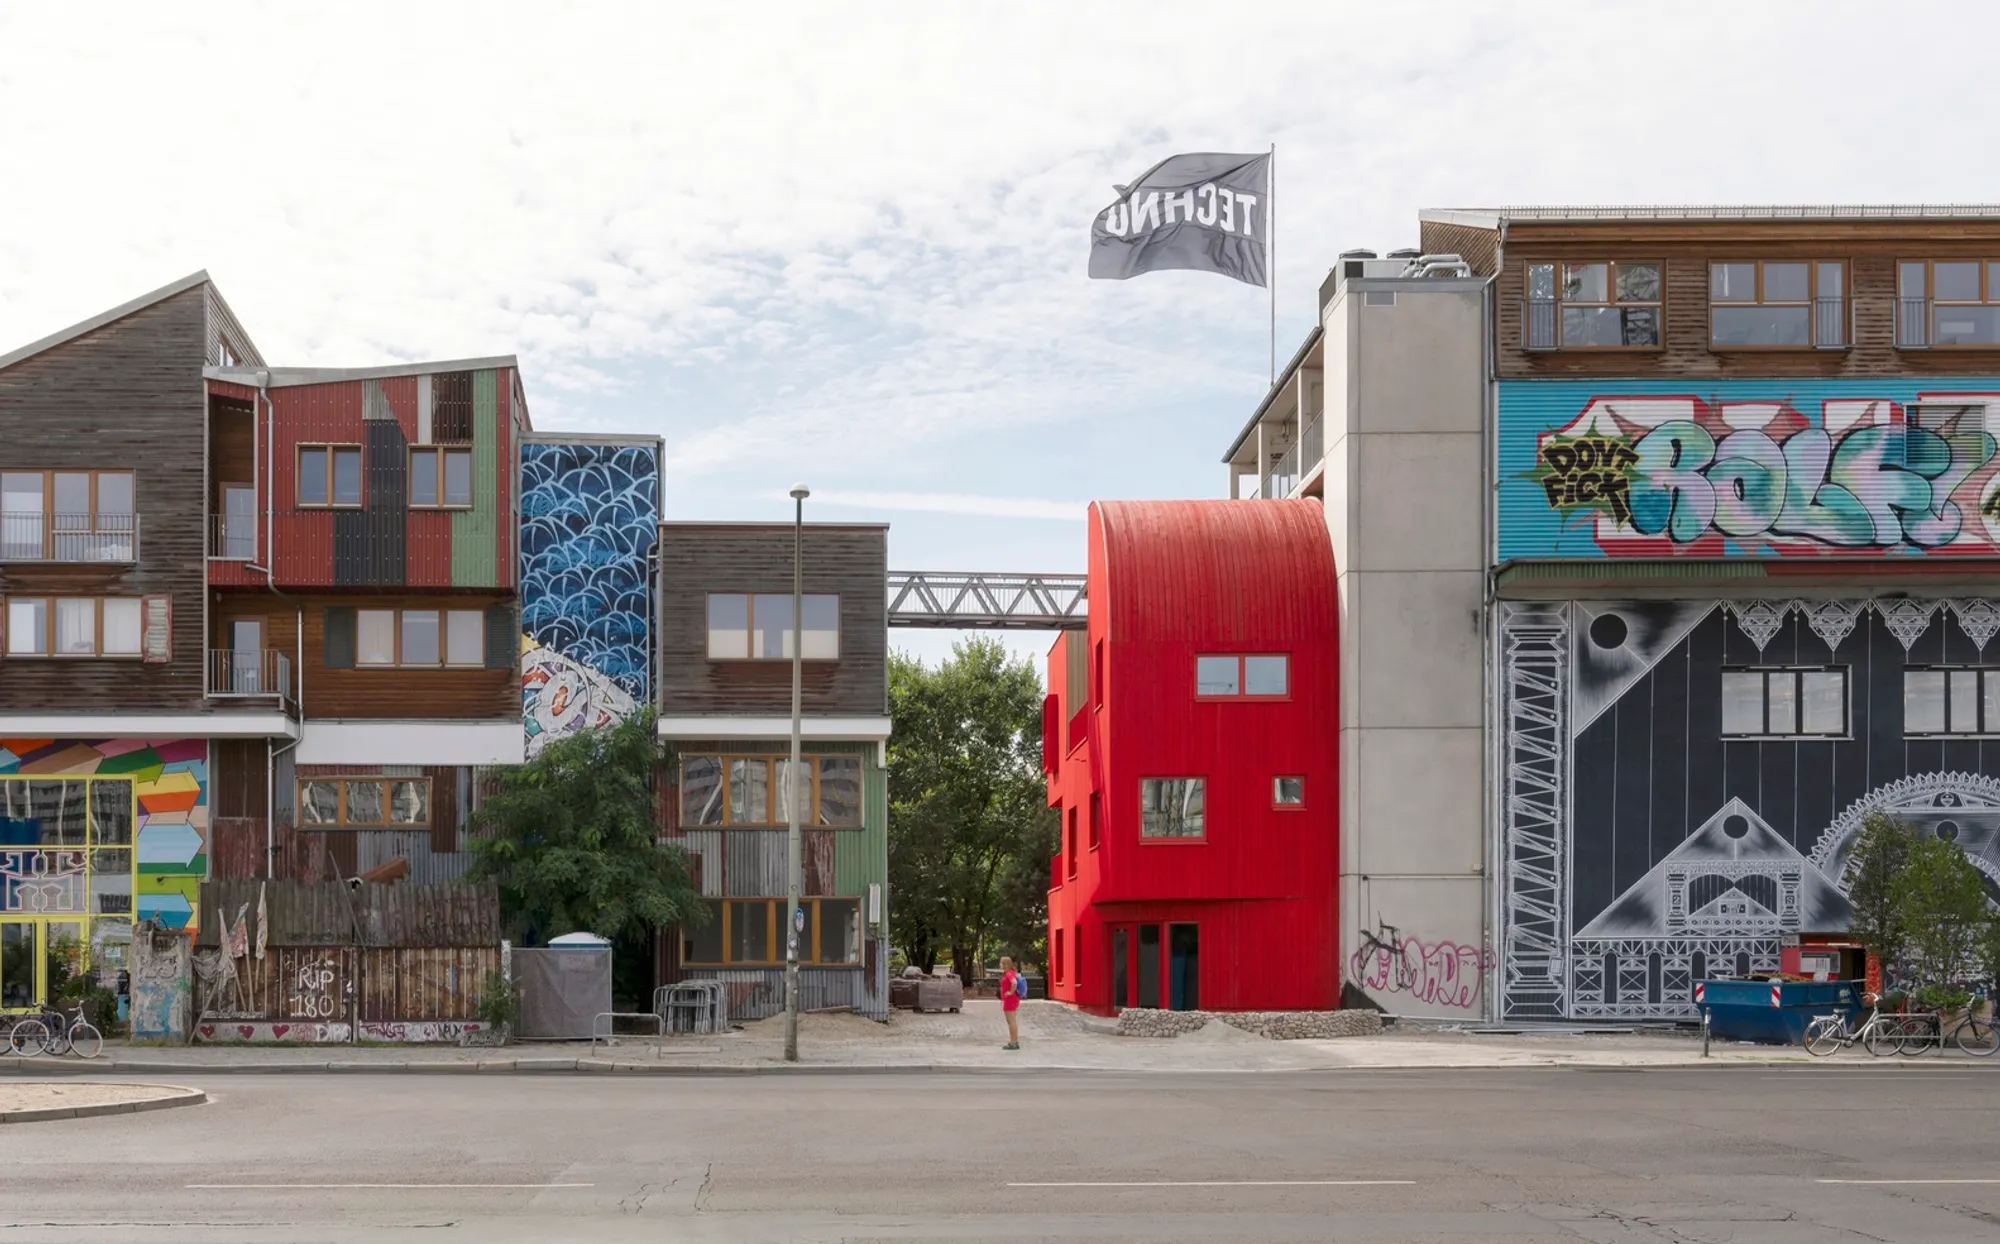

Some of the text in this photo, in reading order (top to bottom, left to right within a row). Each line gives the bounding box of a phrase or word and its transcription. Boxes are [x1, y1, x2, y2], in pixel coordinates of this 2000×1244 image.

[1540, 438, 1642, 478] DONT
[299, 966, 334, 991] RIP
[289, 995, 334, 1018] 180
